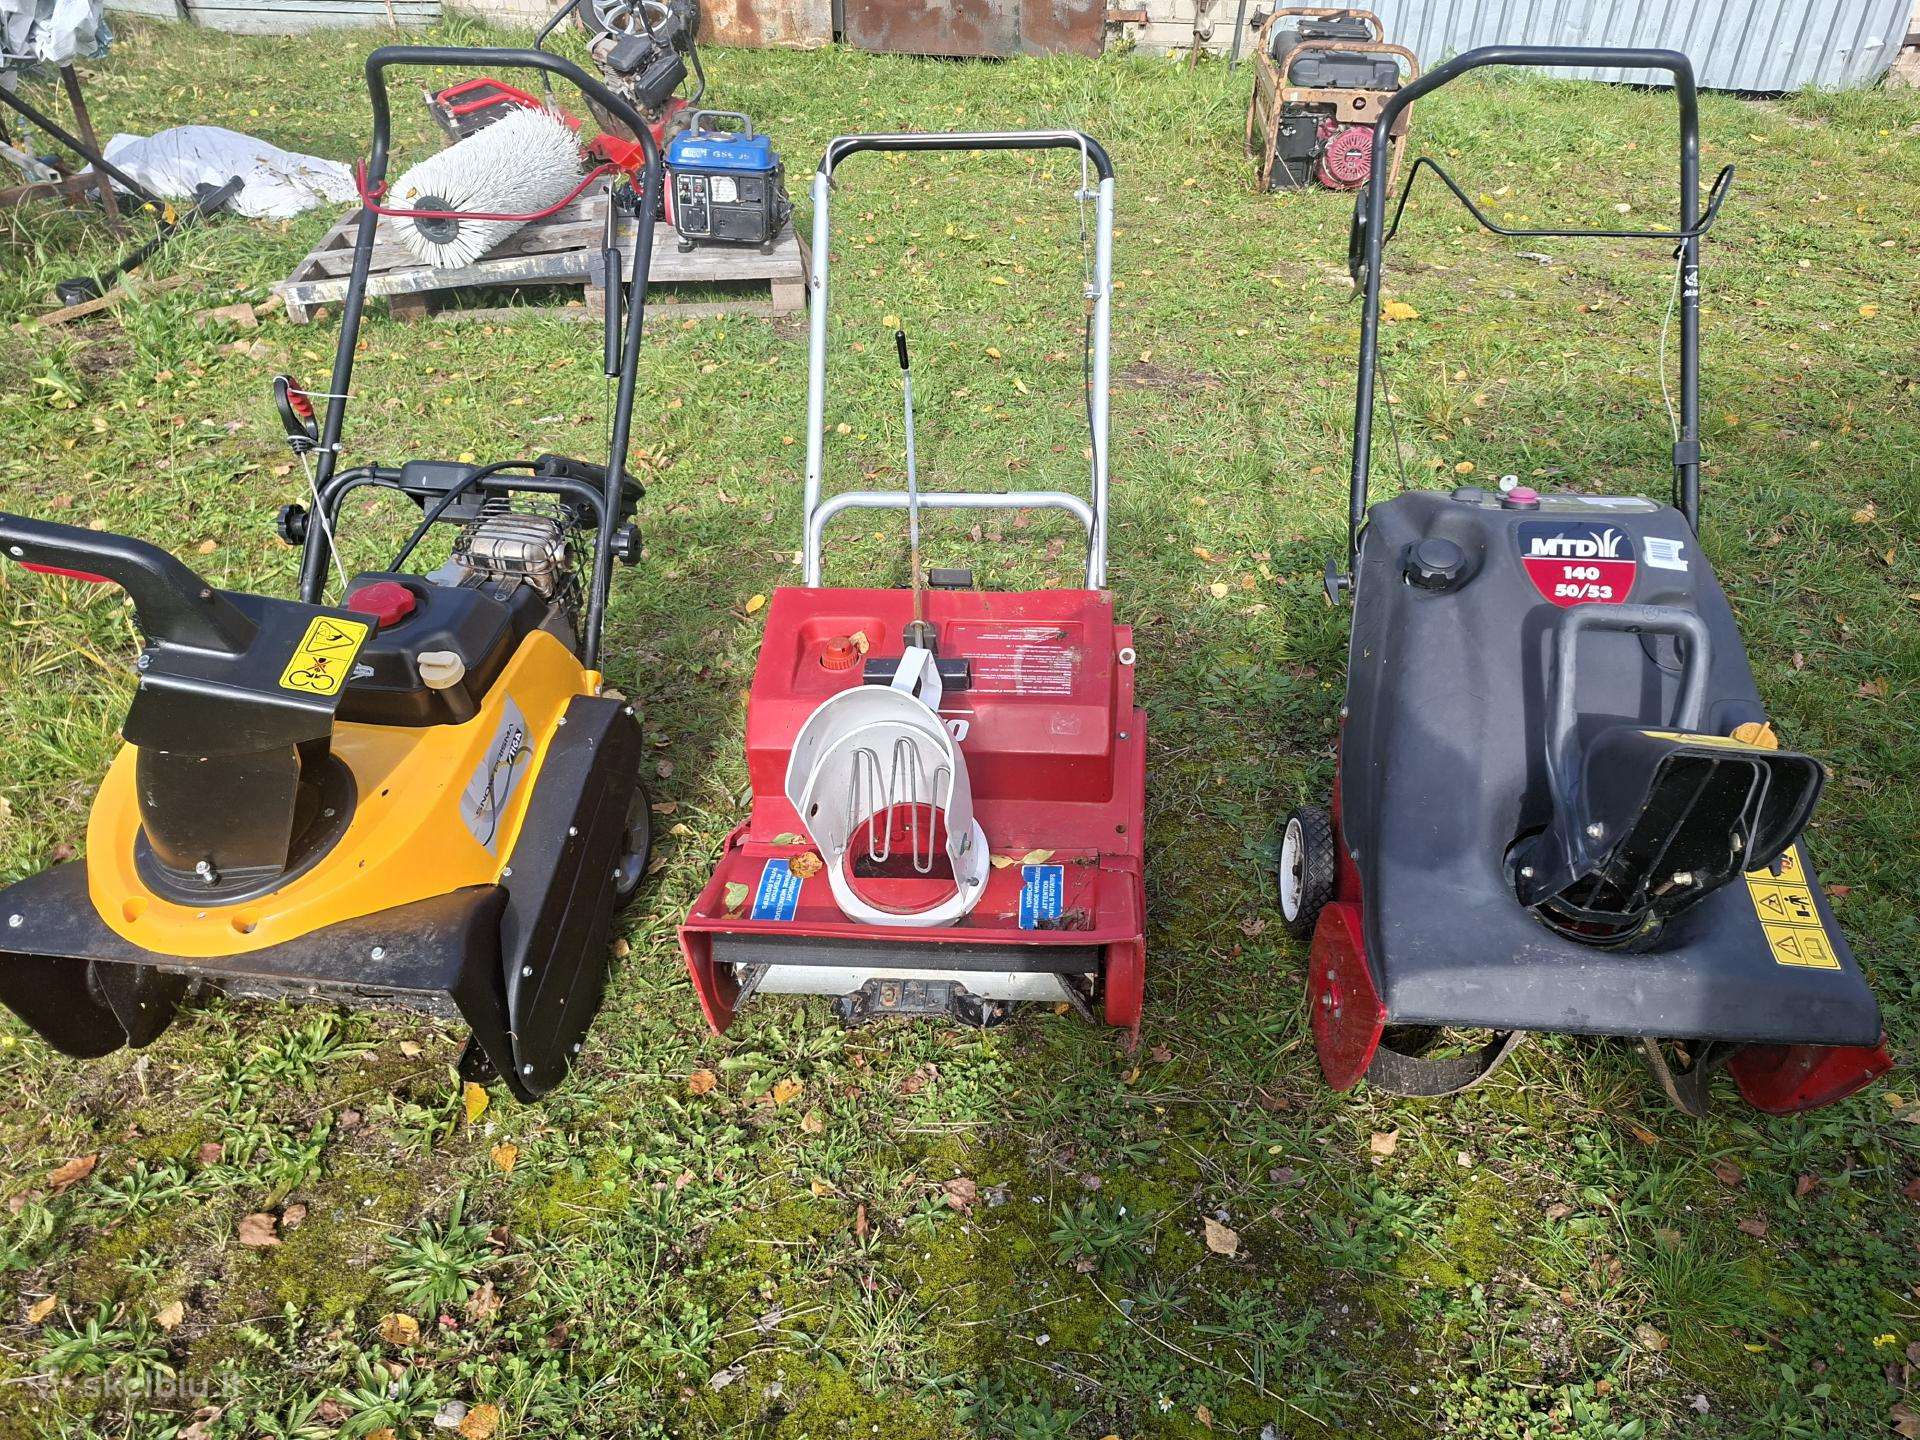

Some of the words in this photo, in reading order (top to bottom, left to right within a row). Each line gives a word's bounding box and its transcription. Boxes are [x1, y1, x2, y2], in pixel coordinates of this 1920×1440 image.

[1531, 537, 1598, 557] MTD
[1563, 566, 1600, 580] 140
[1554, 583, 1613, 598] 50/53
